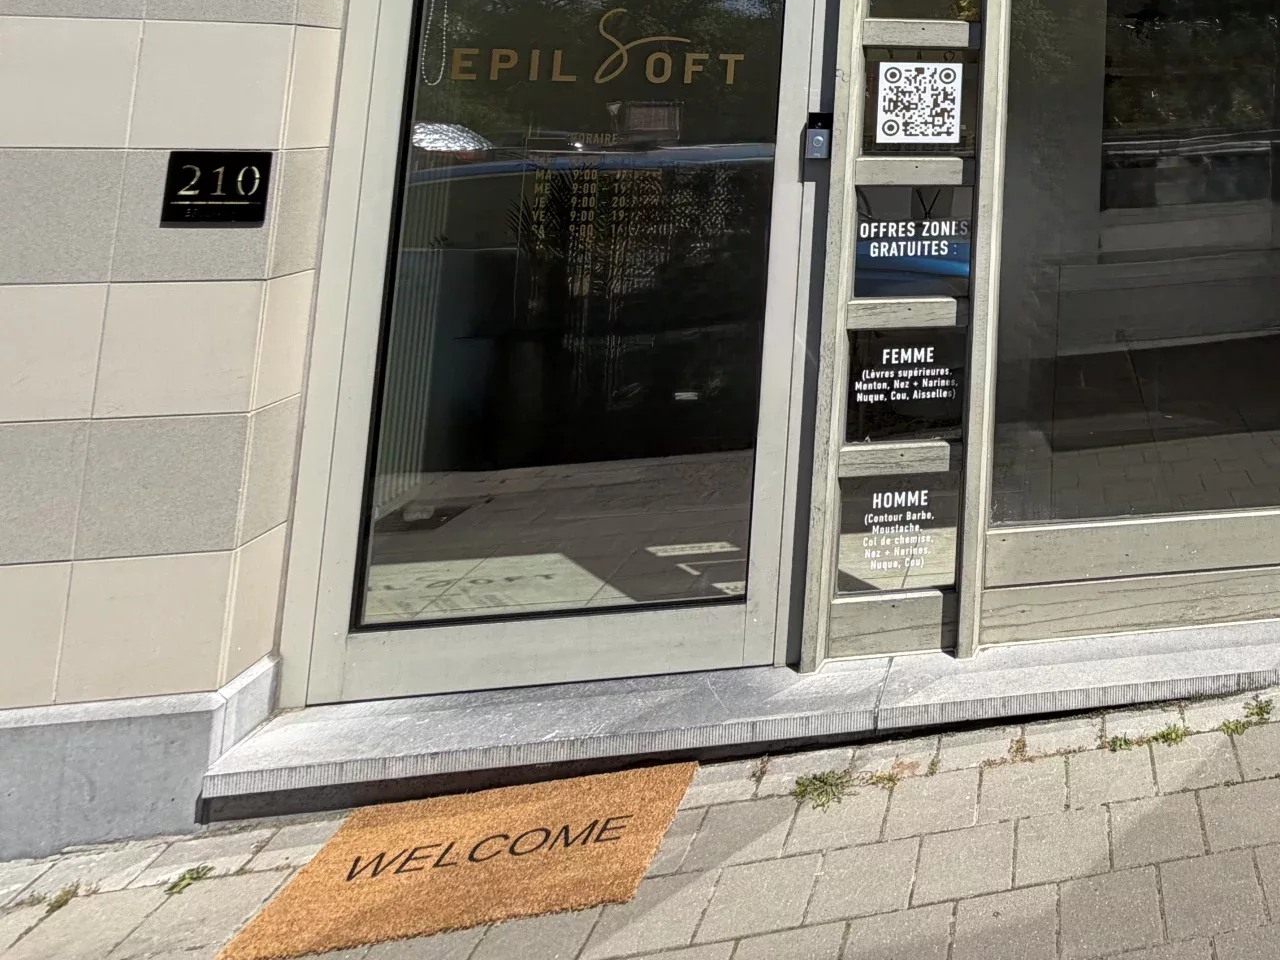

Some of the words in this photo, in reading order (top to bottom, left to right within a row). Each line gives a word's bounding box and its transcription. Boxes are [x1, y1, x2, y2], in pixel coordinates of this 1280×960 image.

[176, 164, 261, 196] 210
[572, 182, 597, 194] 9:00
[571, 196, 596, 208] 9:00
[570, 210, 595, 222] 9:00
[859, 221, 915, 238] OFFRES
[922, 219, 968, 237] ZONES
[869, 240, 949, 257] GRATUITES
[882, 346, 935, 365] FEMME
[862, 368, 895, 381] (Lèvres
[854, 381, 891, 391] Menton,
[893, 379, 910, 389] Nez
[922, 378, 958, 388] Narines,
[856, 392, 888, 404] Nuque,
[890, 391, 910, 401] Cou,
[912, 388, 956, 399] Aisselles)
[872, 490, 929, 509] HOMME
[864, 513, 903, 525] (Contour
[906, 510, 935, 521] Barbe,
[872, 523, 923, 535] Moustache,
[862, 536, 877, 547] Col
[880, 536, 891, 546] de
[894, 534, 934, 545] chemise,
[864, 548, 881, 559] Nez
[904, 556, 925, 568] Cou)
[345, 813, 635, 882] WELCOME
